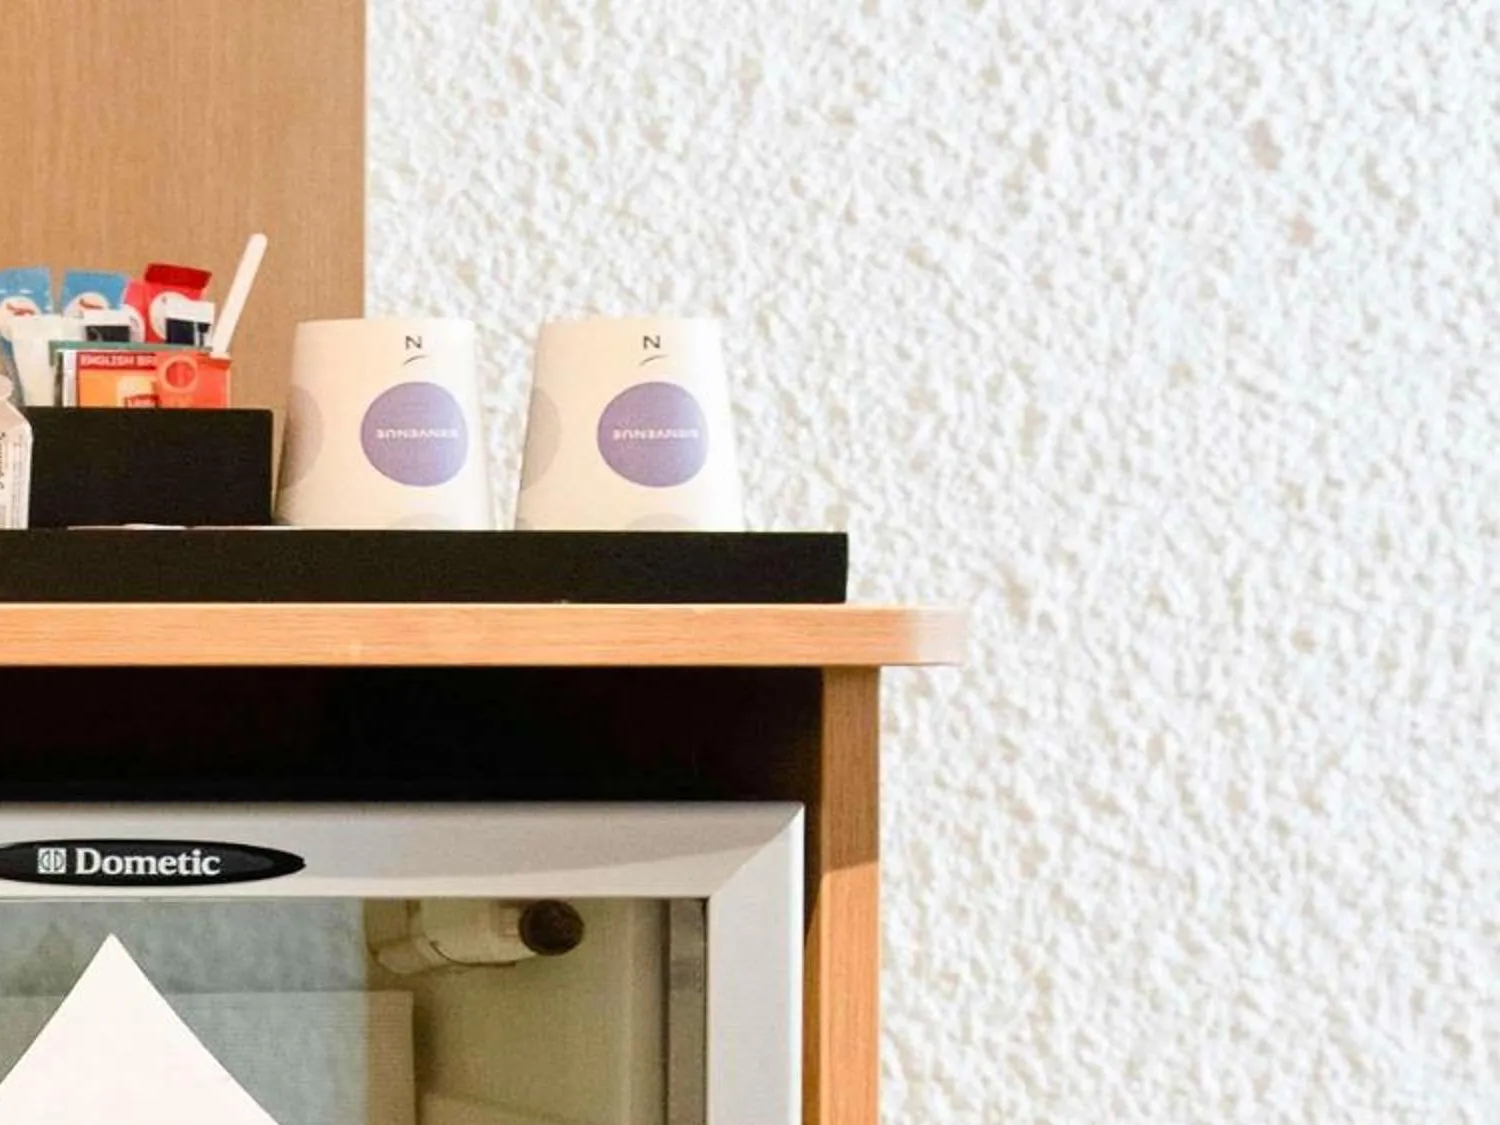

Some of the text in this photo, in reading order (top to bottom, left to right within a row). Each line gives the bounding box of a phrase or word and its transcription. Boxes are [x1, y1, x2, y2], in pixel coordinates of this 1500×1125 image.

[81, 355, 134, 366] ENGLISH
[376, 427, 460, 440] BIENVENUE
[612, 427, 699, 441] BIENVENUE
[74, 848, 221, 876] Dometic
